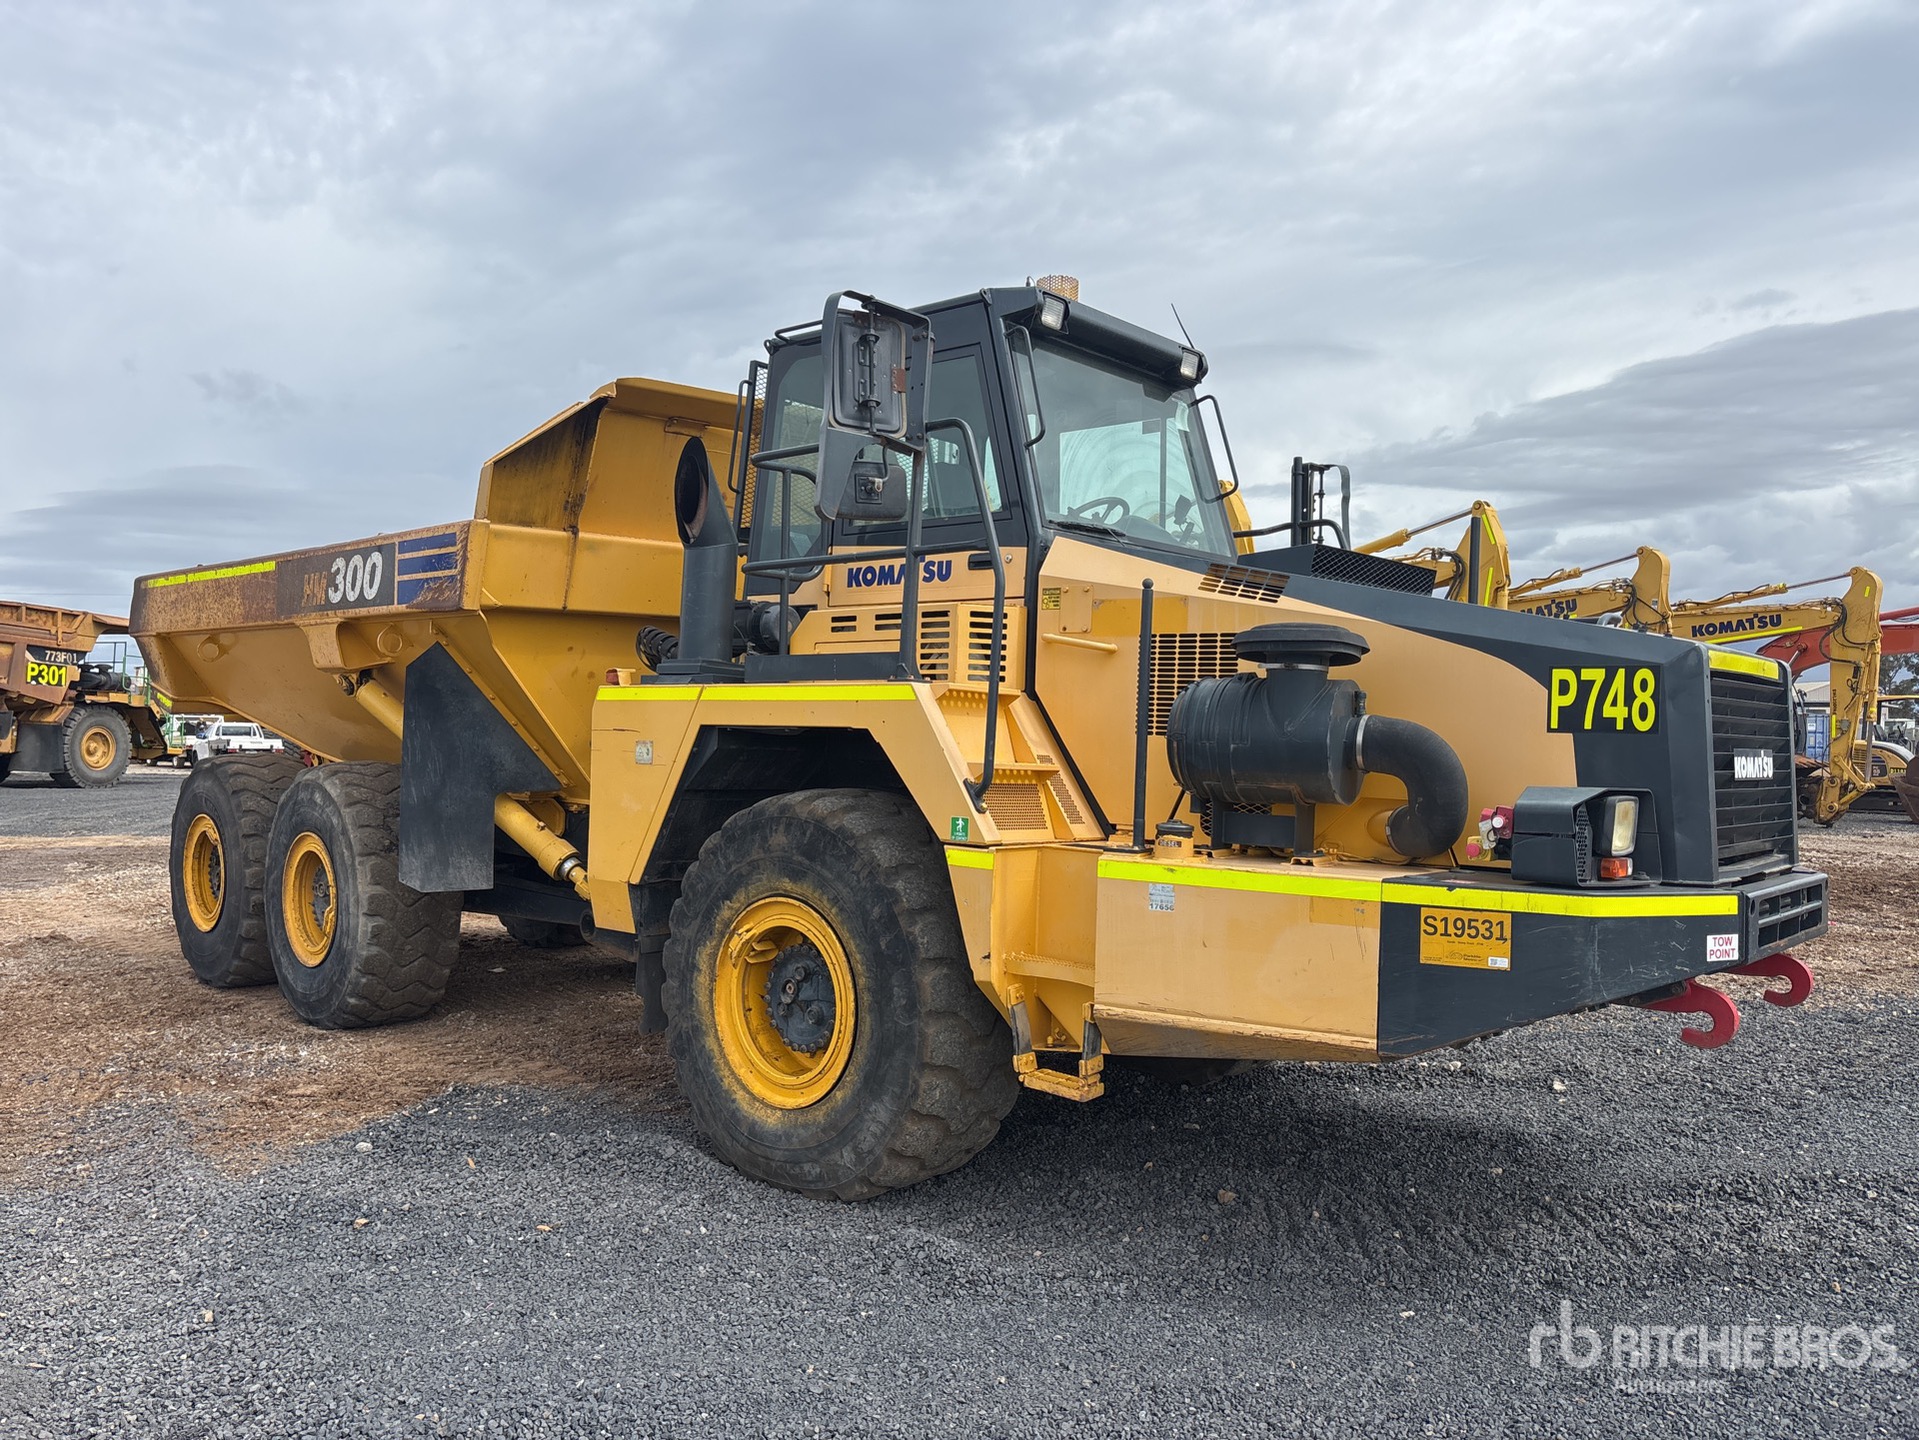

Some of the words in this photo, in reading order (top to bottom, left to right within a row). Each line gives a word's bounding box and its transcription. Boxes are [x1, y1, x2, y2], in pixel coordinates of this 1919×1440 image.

[1691, 613, 1782, 637] KOMATSU
[26, 661, 67, 686] P301
[1550, 667, 1656, 732] P748
[1734, 749, 1774, 779] KOMATSU
[1422, 915, 1508, 941] S19531
[1709, 948, 1736, 960] POINT
[1712, 936, 1733, 947] TOW
